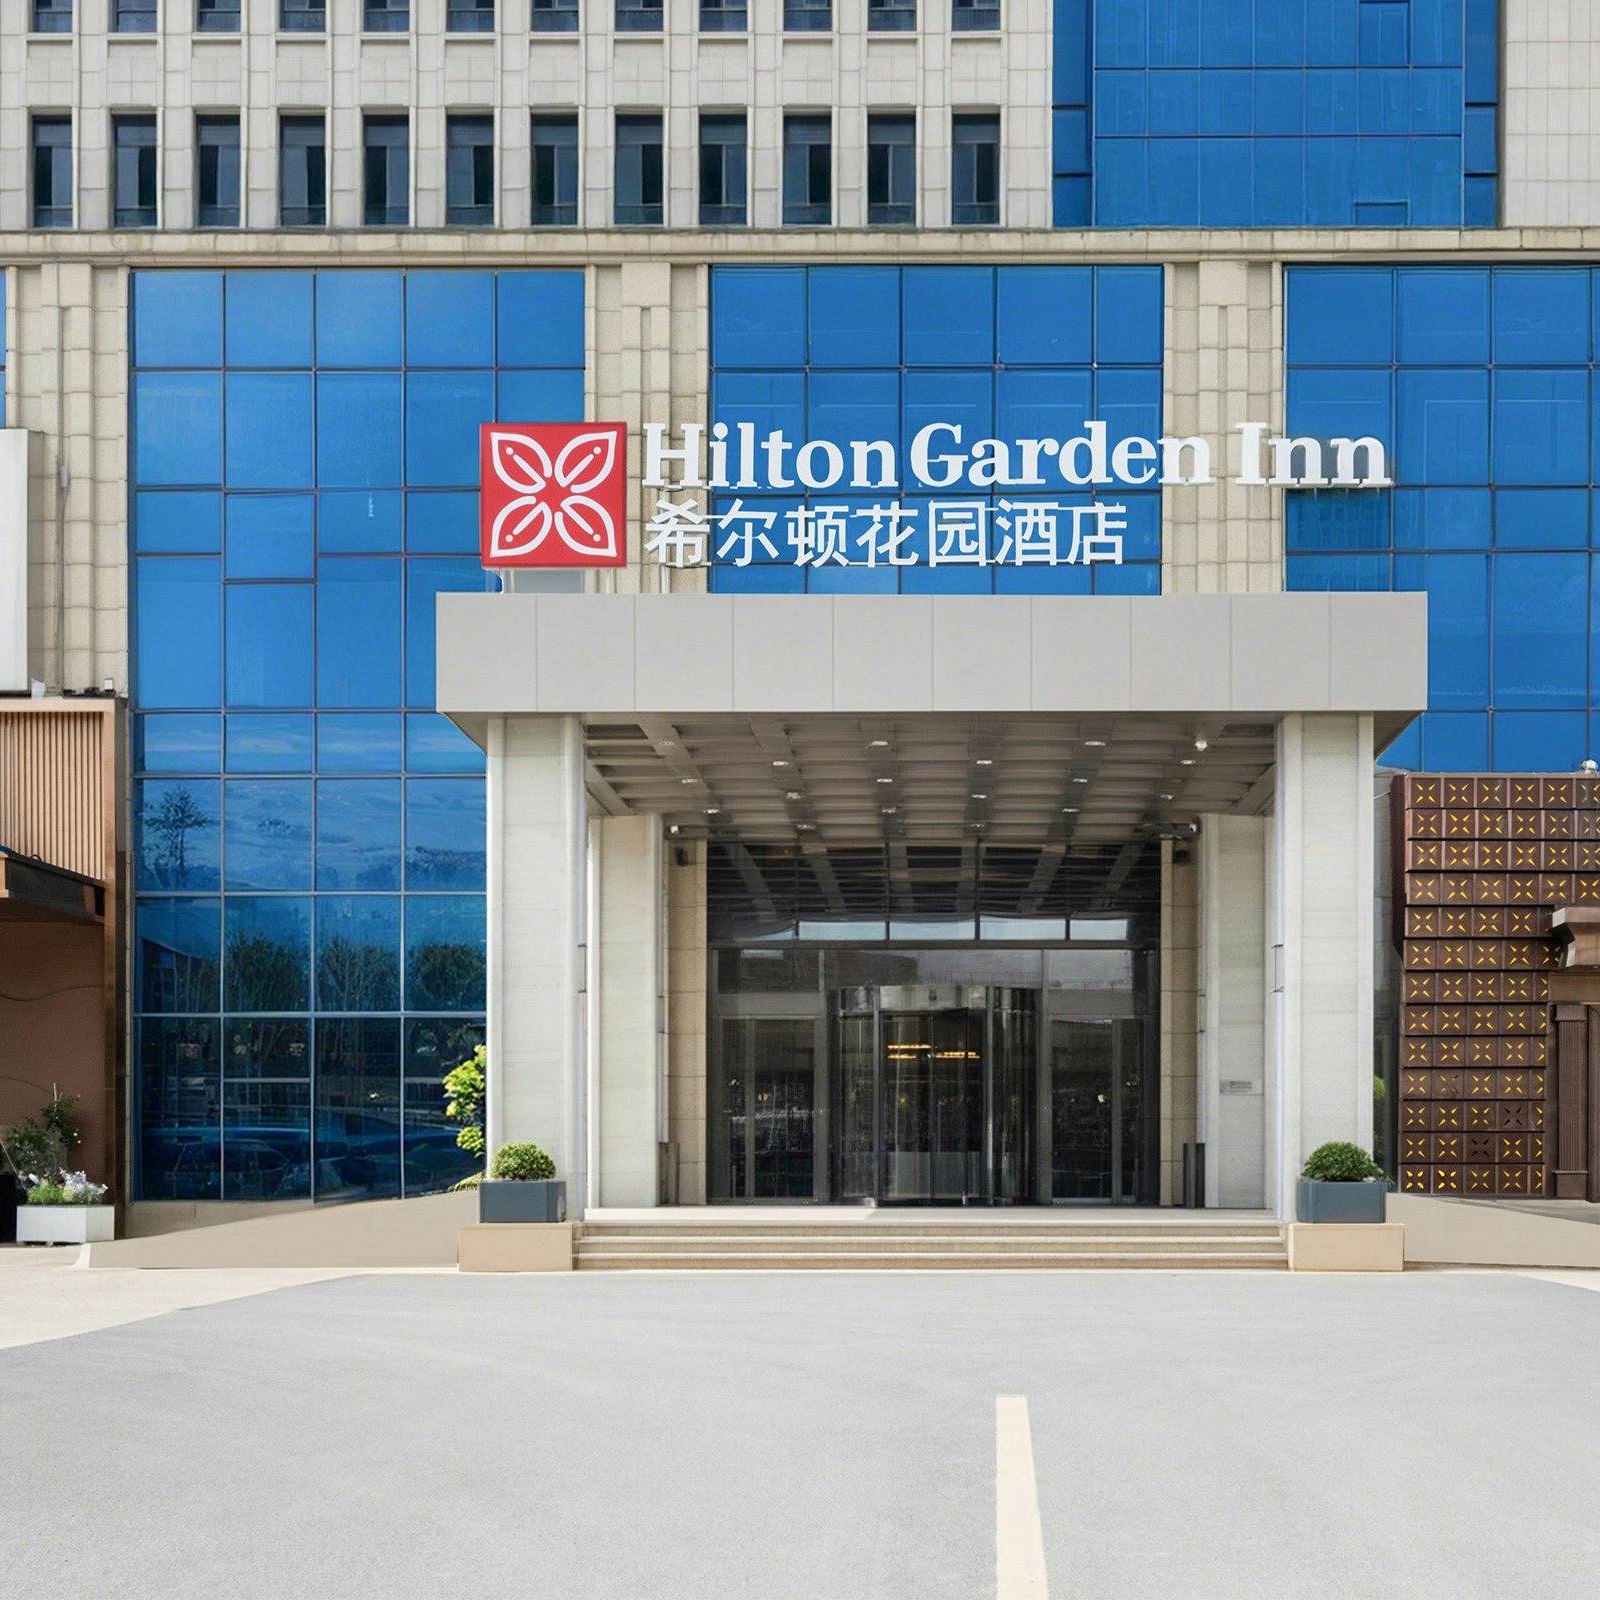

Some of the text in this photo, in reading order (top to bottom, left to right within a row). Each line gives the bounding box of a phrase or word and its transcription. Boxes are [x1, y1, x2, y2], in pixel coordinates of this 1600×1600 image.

[642, 421, 1394, 489] Hilton Garden Inn
[643, 498, 1128, 568] 希尔顿花园酒店
